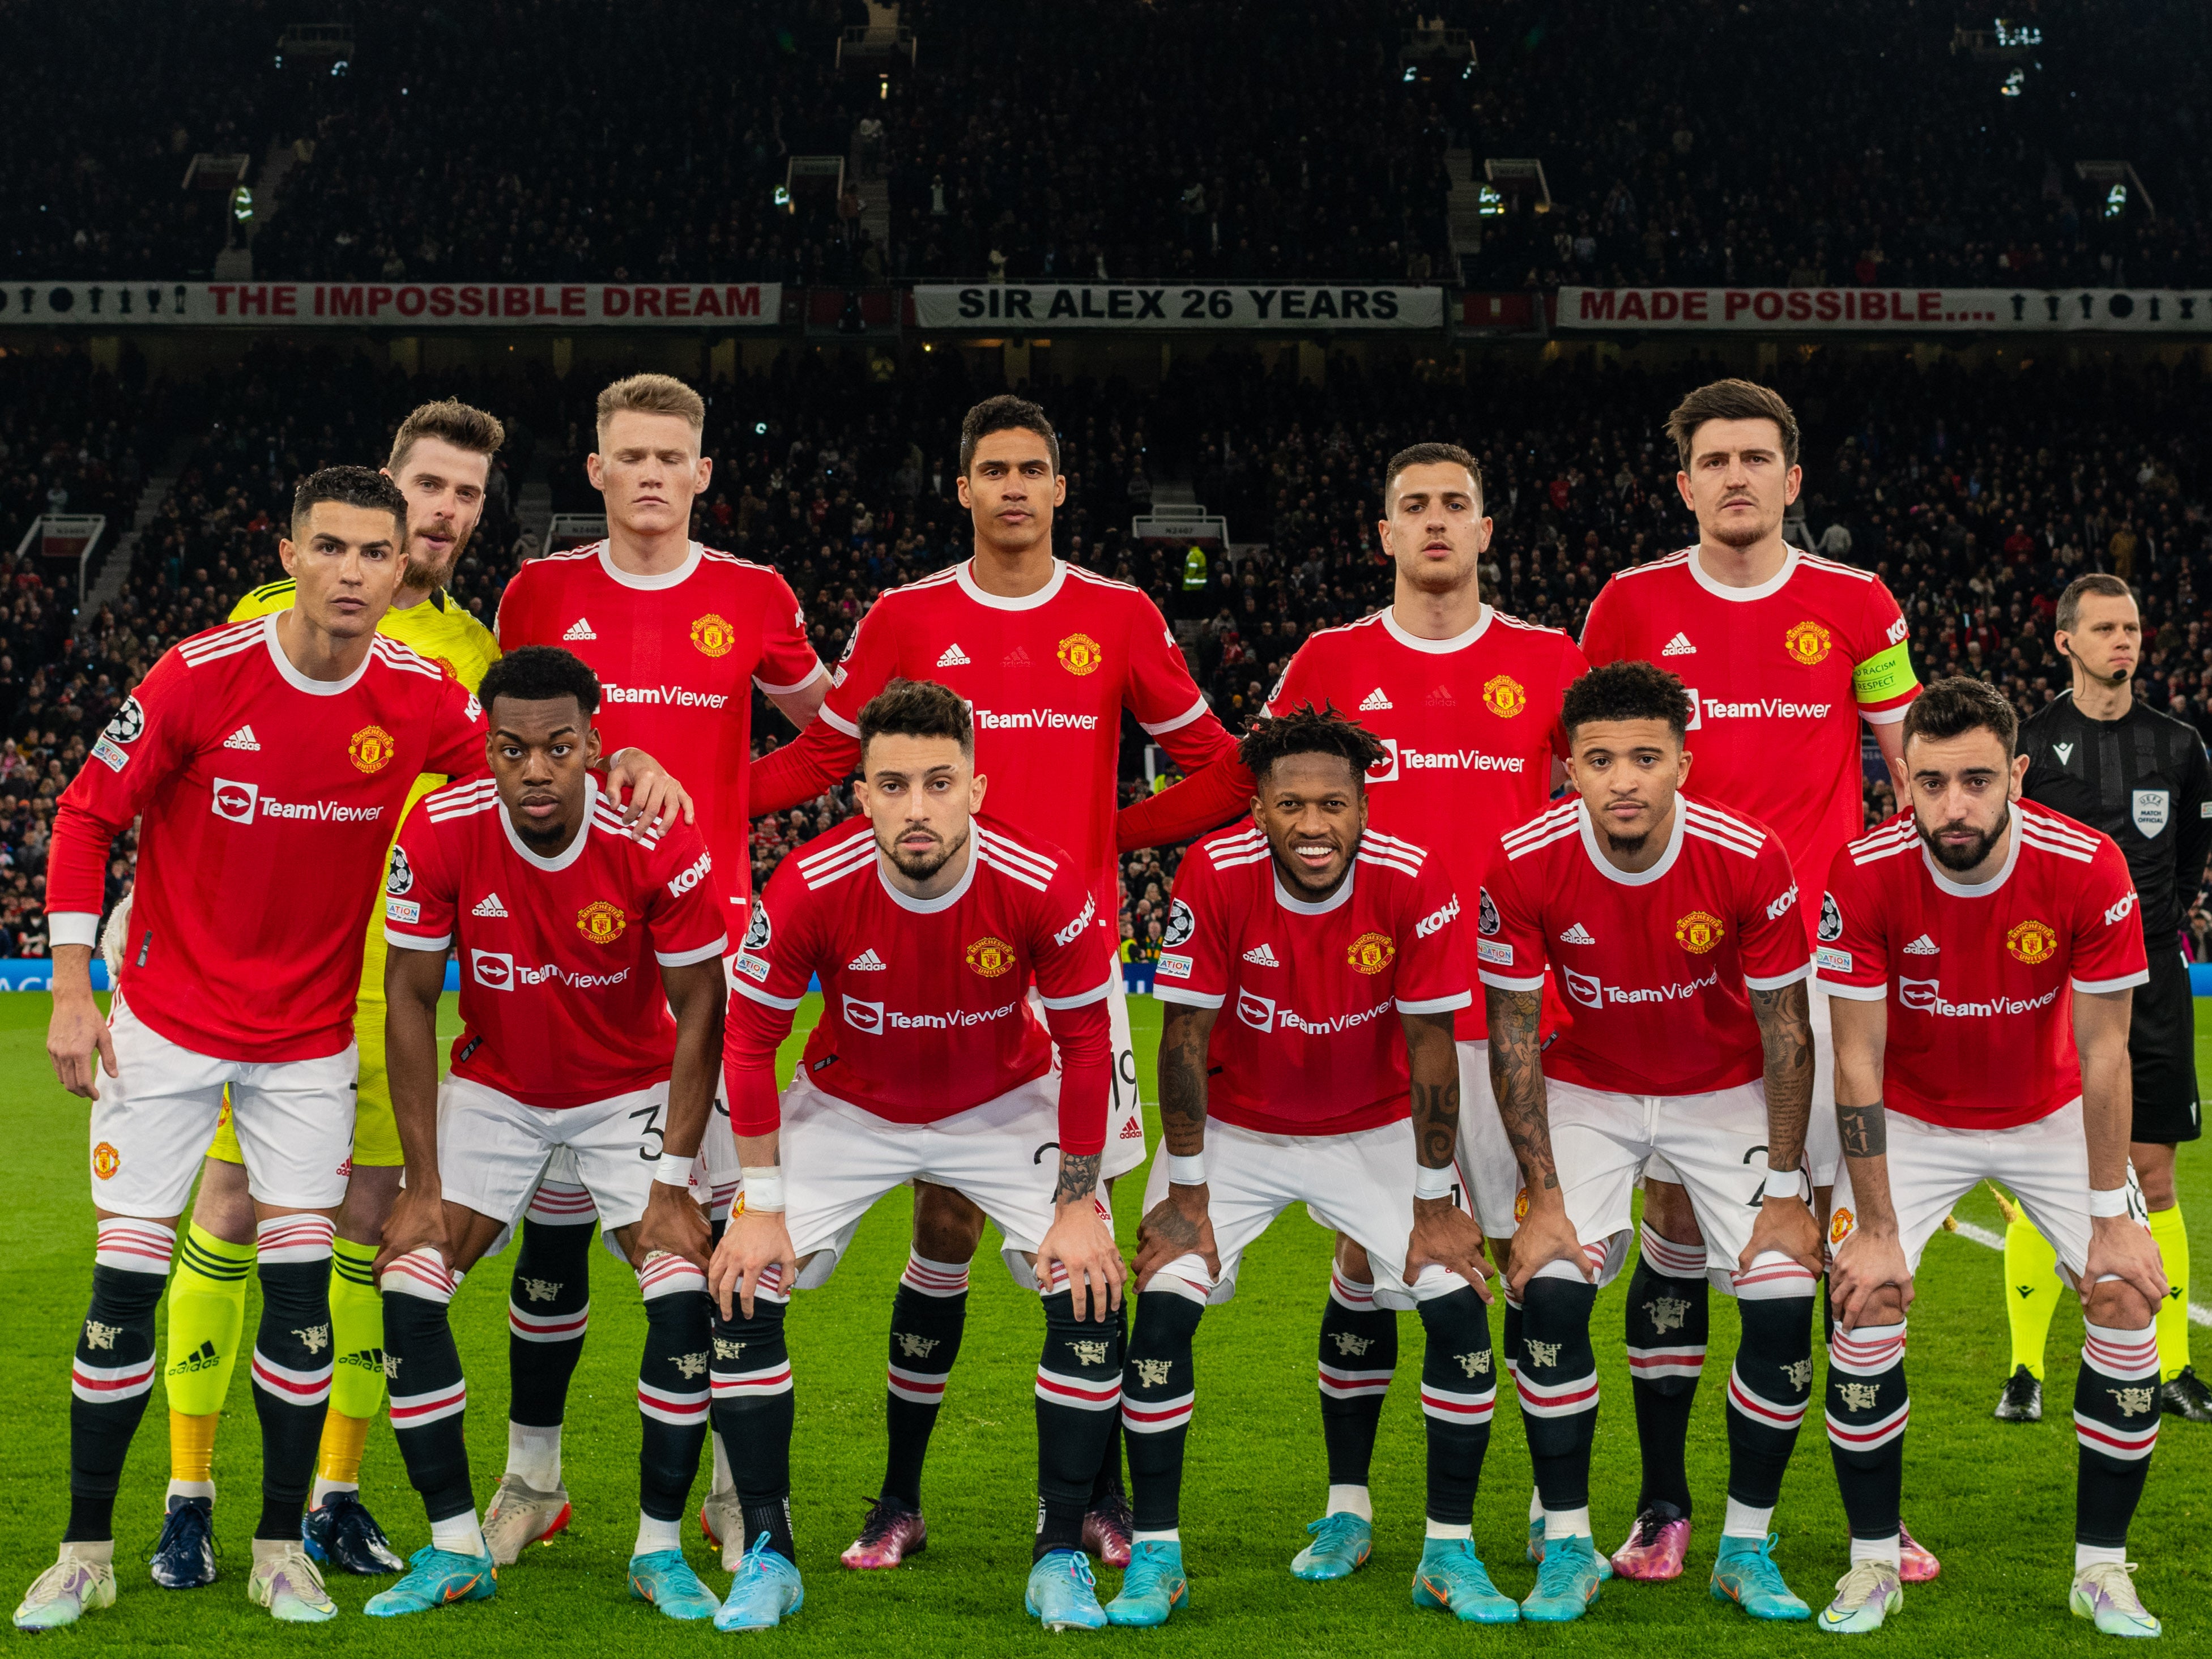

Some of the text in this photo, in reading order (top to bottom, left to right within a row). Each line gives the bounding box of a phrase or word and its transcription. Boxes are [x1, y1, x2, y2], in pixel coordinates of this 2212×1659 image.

[208, 286, 761, 317] THE IMPOSSIBLE DREAM
[958, 289, 1399, 319] SIR ALEX 26 YEARS
[1579, 291, 1708, 321] MADE
[695, 617, 731, 633] MANCHESTER
[1789, 625, 1827, 639] MANCHESTER
[1062, 636, 1097, 652] MANCHESTER
[1661, 646, 1697, 656] adidas
[937, 657, 970, 667] adidas
[1067, 665, 1092, 673] UNITED
[1864, 660, 1896, 676] RACISM
[1488, 678, 1521, 694] MANCHESTER
[1858, 676, 1894, 690] RESPECT
[602, 684, 728, 709] TeamViewer
[1359, 701, 1393, 711] adidas
[1702, 698, 1831, 718] TeamViewer
[976, 709, 1098, 730] TeamViewer
[223, 739, 261, 751] adidas
[354, 728, 391, 746] MANCHESTER
[356, 761, 382, 770] UNITED
[1400, 749, 1524, 773] TeamViewer
[2140, 795, 2163, 805] UEFA
[259, 797, 383, 821] TeamViewer
[472, 908, 508, 918] adidas
[582, 905, 621, 919] MANCHESTER
[1680, 914, 1719, 929] MANCHESTER
[2011, 923, 2052, 939] MANCHESTER
[970, 940, 1011, 954] MANCHESTER
[1351, 935, 1390, 953] MANCHESTER
[1559, 935, 1595, 945] adidas
[1687, 941, 1715, 951] UNITED
[1903, 946, 1940, 955] adidas
[2019, 952, 2048, 962] UNITED
[849, 962, 886, 971] adidas
[1243, 953, 1280, 967] adidas
[1360, 960, 1387, 973] UNITED
[515, 964, 630, 988] TeamViewer
[978, 966, 1006, 975] UNITED
[1936, 986, 2059, 1017] TeamViewer
[886, 1001, 1016, 1029] TeamViewer
[1277, 995, 1395, 1034] TeamViewer
[1111, 1050, 1137, 1112] 19
[628, 1104, 664, 1161] 3
[169, 1356, 220, 1376] adidas
